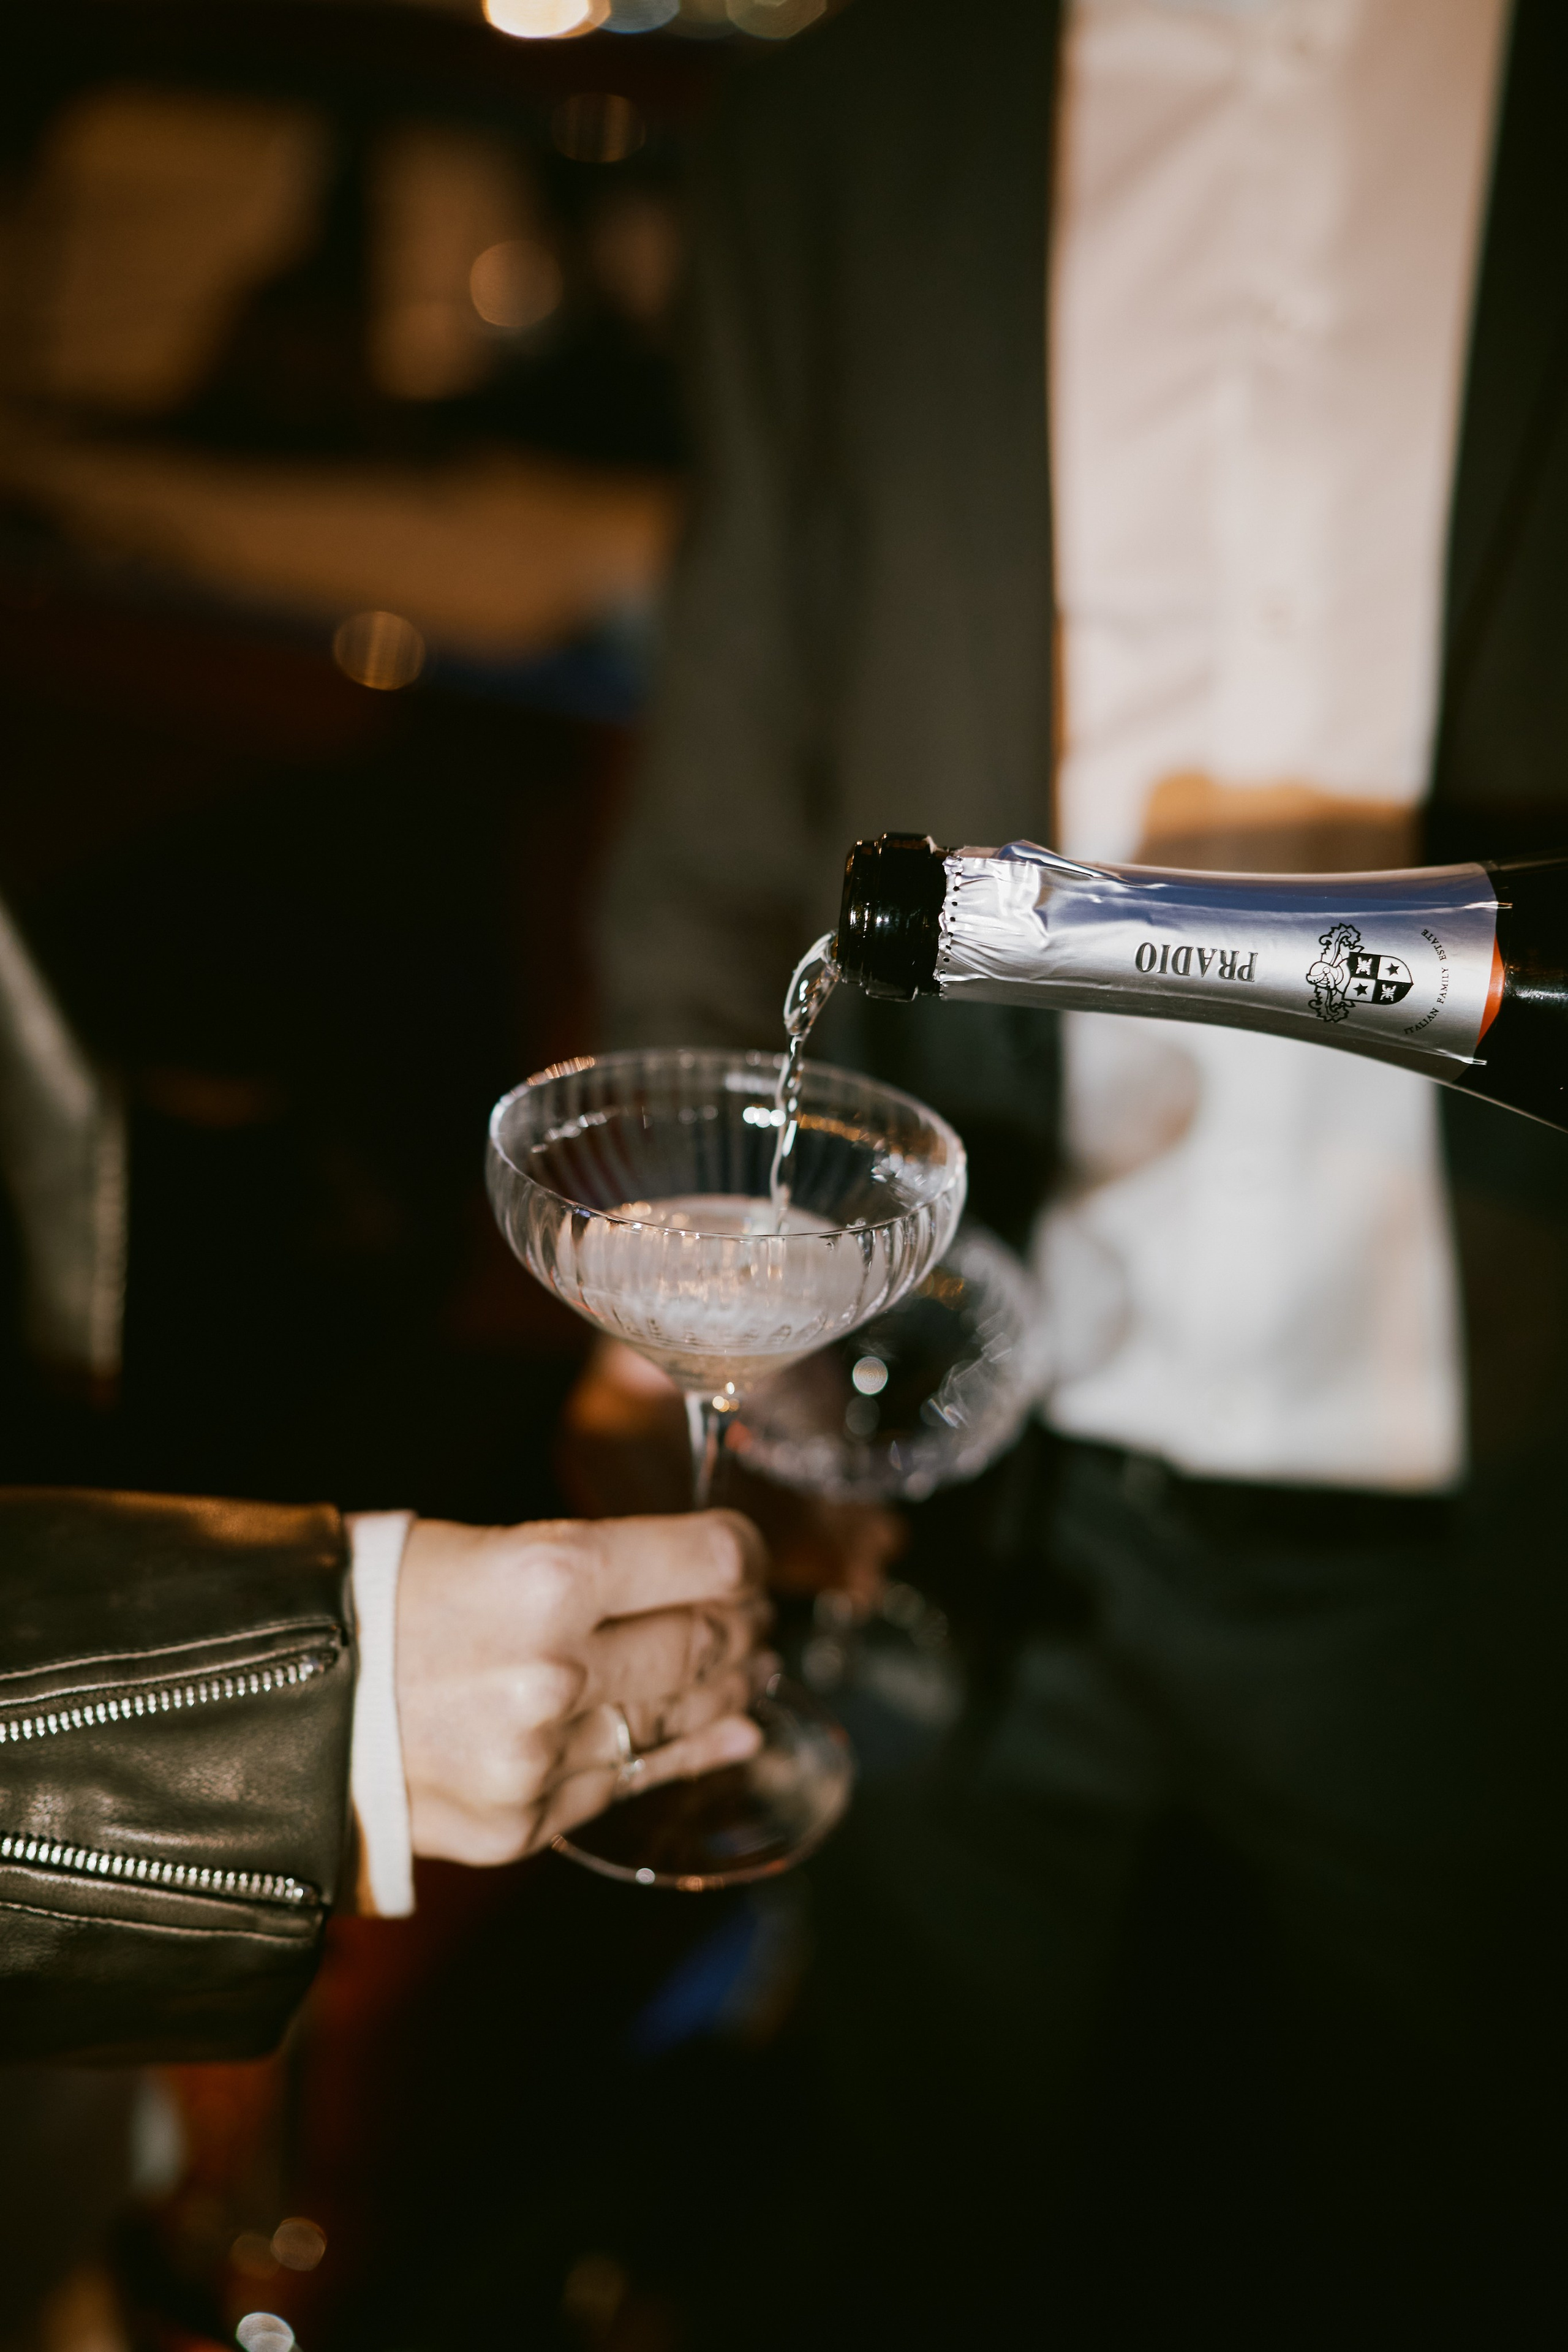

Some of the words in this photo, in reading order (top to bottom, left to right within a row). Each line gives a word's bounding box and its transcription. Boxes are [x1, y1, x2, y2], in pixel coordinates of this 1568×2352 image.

[1135, 942, 1258, 982] PRADIO
[1421, 929, 1447, 961] ESTATE
[1436, 967, 1449, 1004] FAMILY
[1404, 1008, 1439, 1035] ITALIAN
